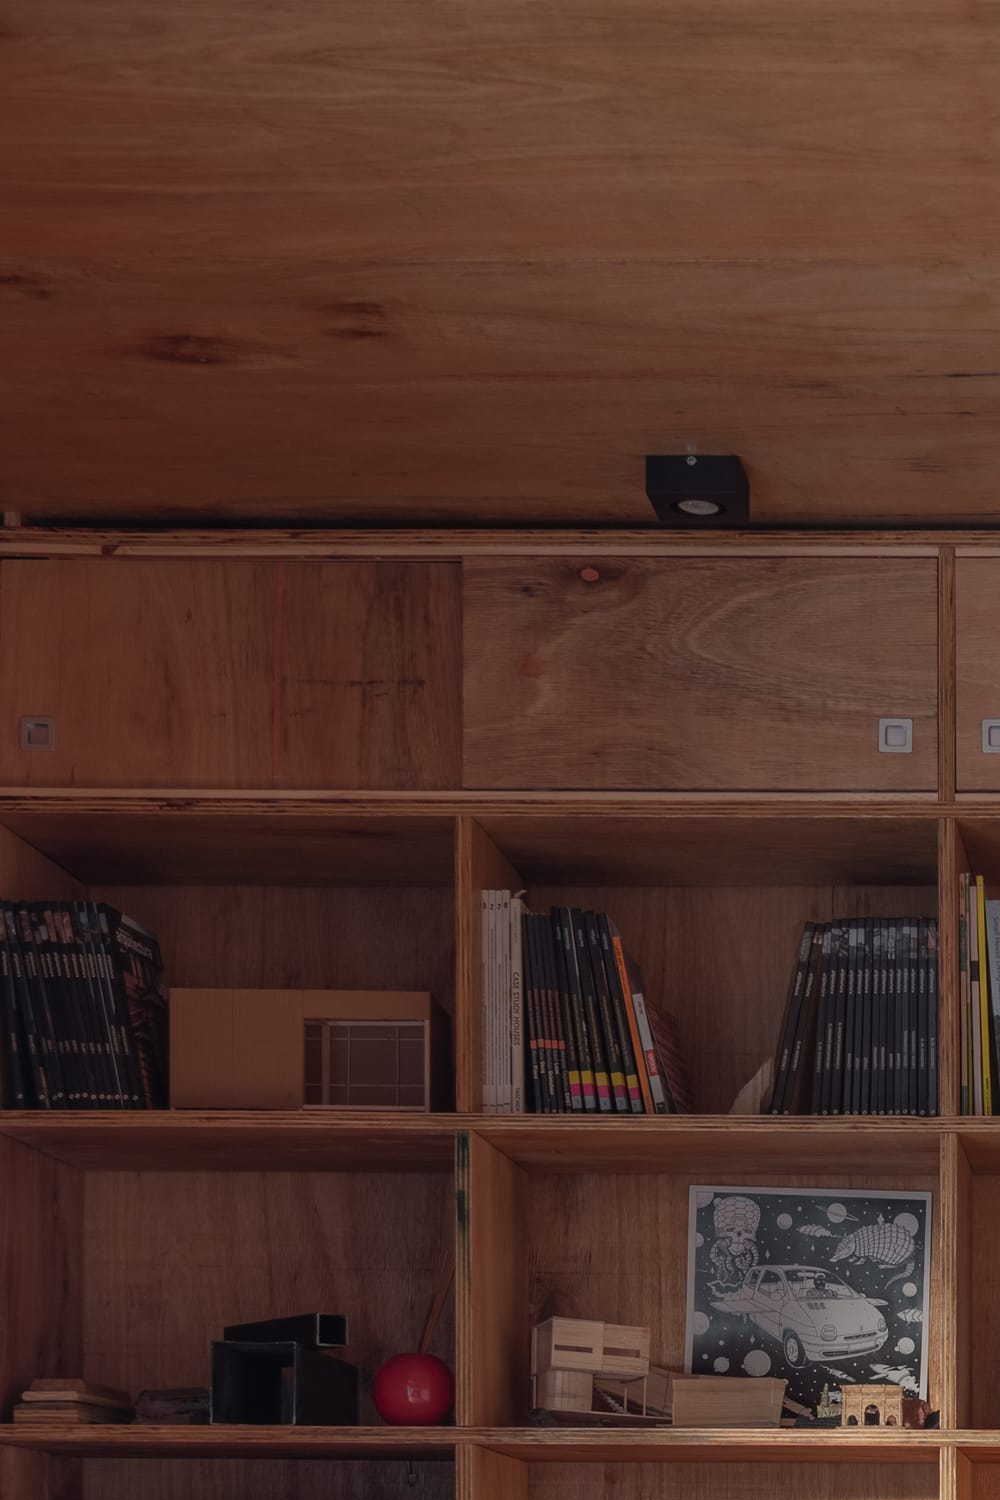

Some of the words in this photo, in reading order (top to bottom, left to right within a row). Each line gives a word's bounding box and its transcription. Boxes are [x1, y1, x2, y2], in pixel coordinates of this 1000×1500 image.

[991, 916, 1000, 935] Small
[512, 971, 521, 990] CASE
[512, 992, 521, 1015] STUDY
[512, 1016, 521, 1046] HOUSES
[513, 1087, 521, 1112] TASCHEN
